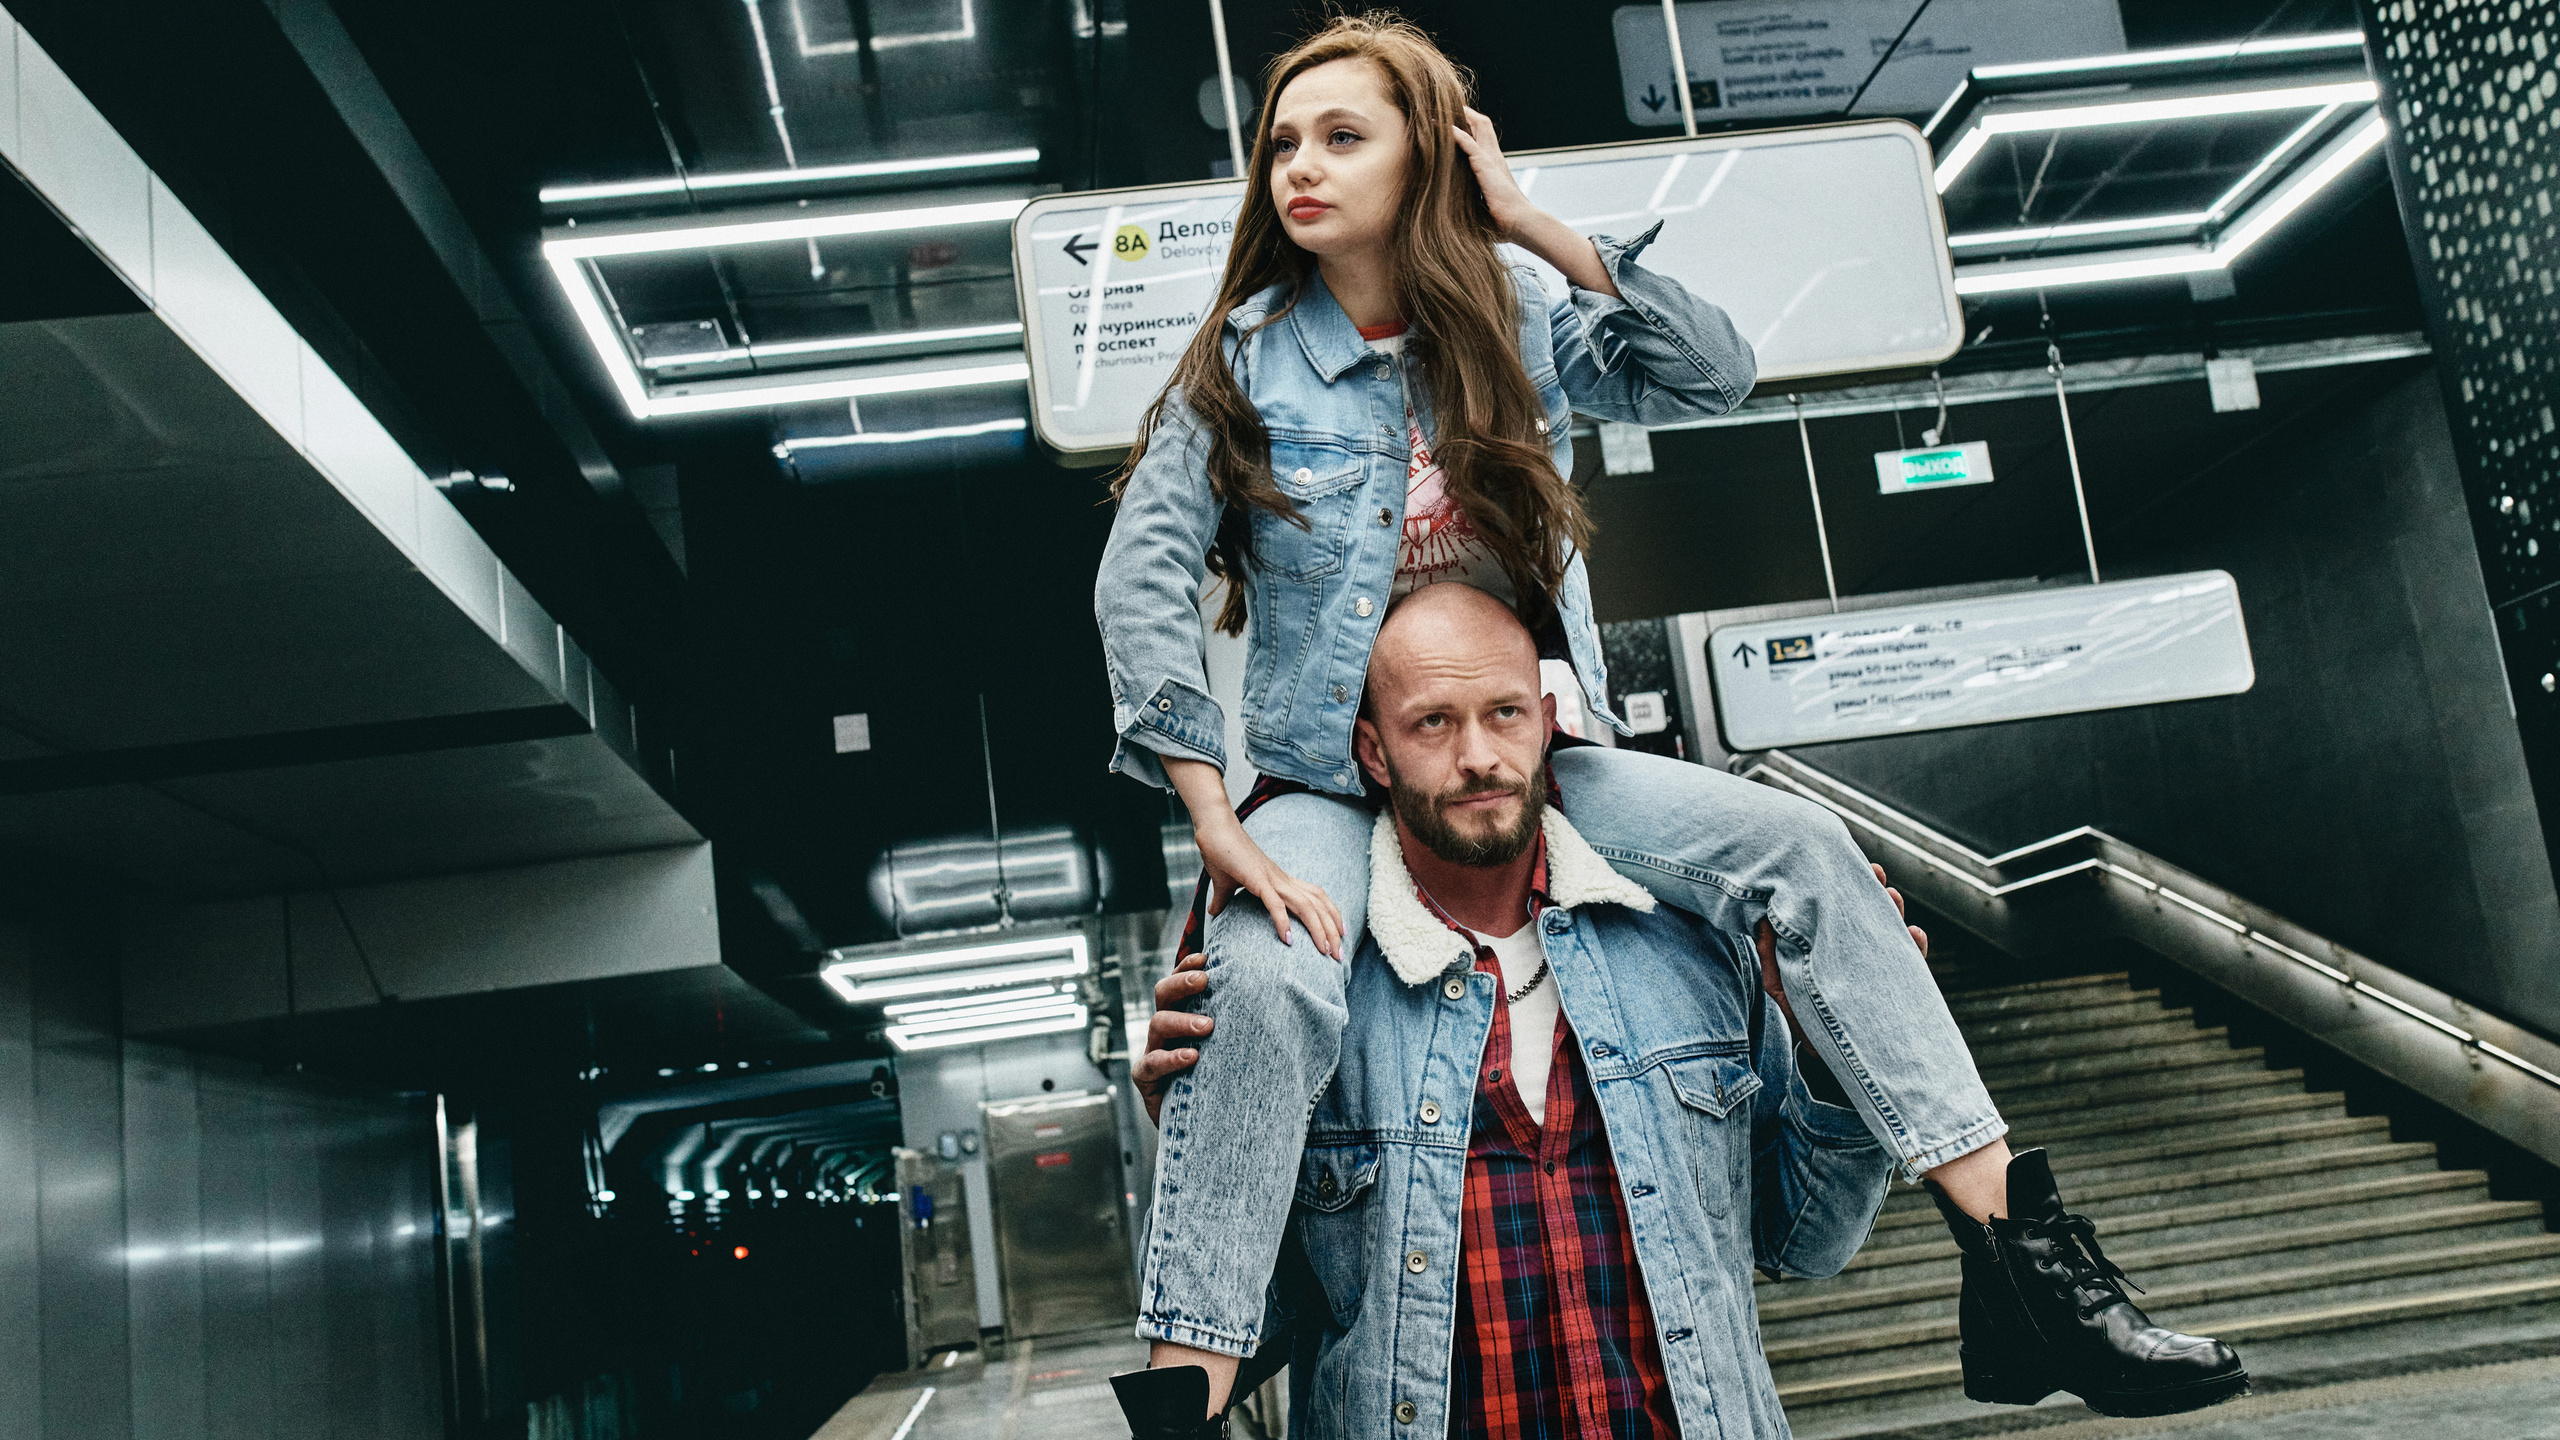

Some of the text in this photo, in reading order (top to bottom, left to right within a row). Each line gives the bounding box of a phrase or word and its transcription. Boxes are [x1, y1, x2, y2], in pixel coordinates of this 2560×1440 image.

[1159, 221, 1233, 242] Делов
[1068, 283, 1145, 299] Озрная
[1075, 336, 1157, 354] поспект
